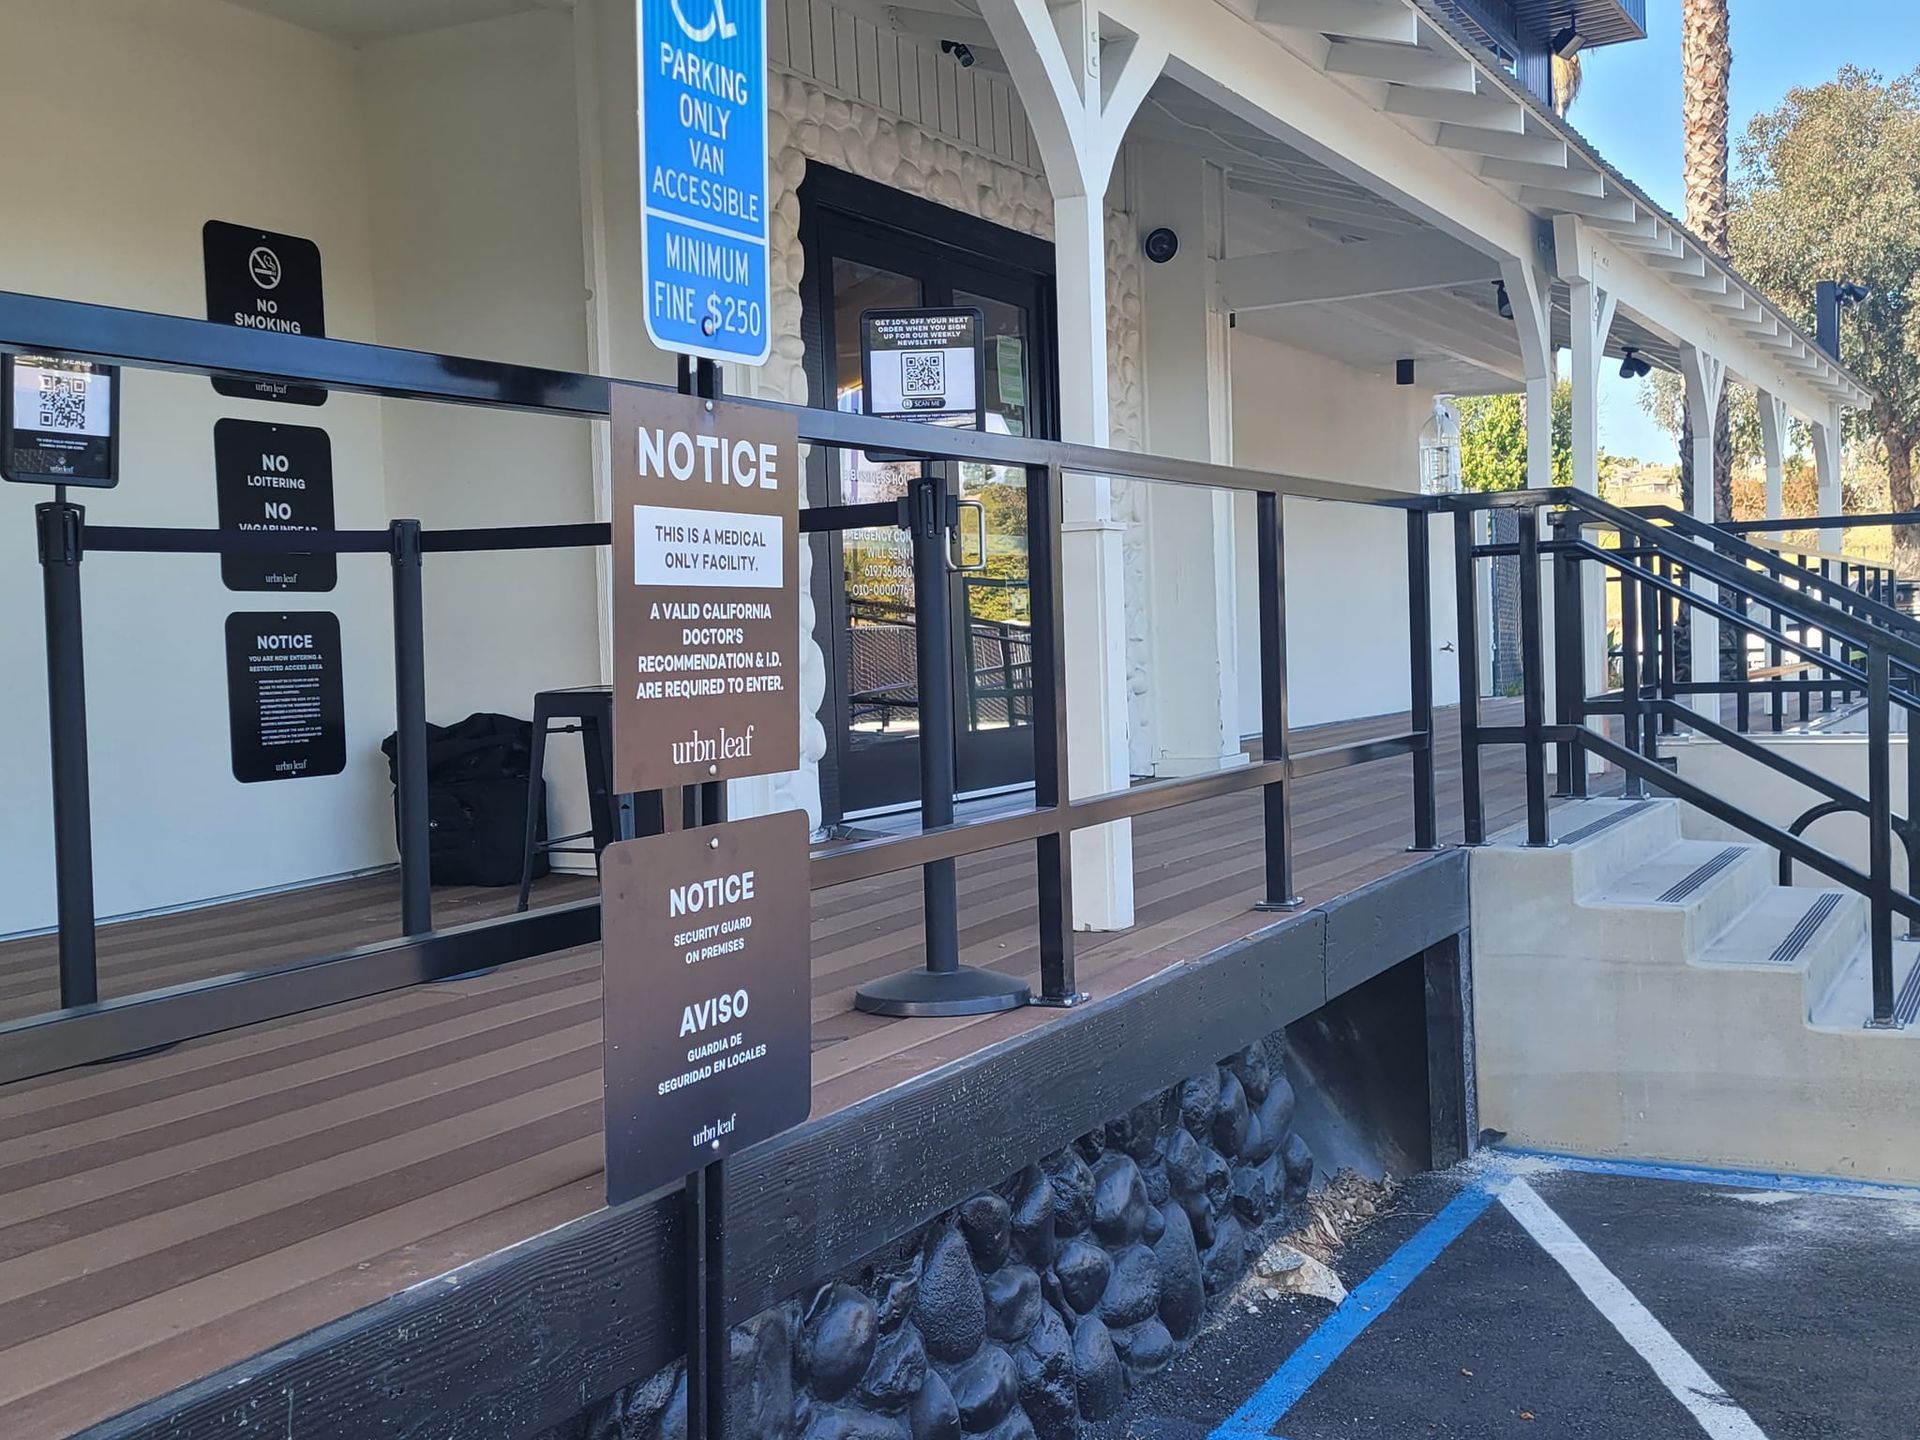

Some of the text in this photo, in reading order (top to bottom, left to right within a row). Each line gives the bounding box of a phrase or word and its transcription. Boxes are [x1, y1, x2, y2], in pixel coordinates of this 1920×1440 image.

[660, 43, 747, 105] PARKING
[679, 93, 731, 140] ONLY
[689, 138, 724, 176] VAN
[652, 166, 759, 222] ACCESSIBLE
[666, 232, 749, 286] MINIMUM
[257, 298, 277, 314] NO
[655, 281, 760, 336] FINE $250
[234, 312, 301, 334] SMOKING
[948, 316, 968, 324] NEXT
[897, 338, 947, 346] NEWSLETTER
[930, 330, 961, 338] WEEKLY
[914, 399, 930, 408] SCAN
[262, 454, 289, 472] NO
[639, 426, 778, 490] NOTICE
[247, 475, 306, 490] LOITERING
[265, 502, 292, 520] NO
[655, 525, 766, 547] THIS IS A MEDICAL
[665, 552, 758, 571] ONLY FACILITY.
[650, 603, 772, 620] A VALID CALIFORNIA
[257, 634, 313, 650] NOTICE
[682, 628, 743, 646] DOCTOR'S
[638, 651, 782, 673] RECOMMENDATION & I.D.
[636, 675, 784, 700] ARE REQUIRED TO ENTER.
[672, 724, 754, 765] urbn leaf
[669, 870, 755, 918] NOTICE
[674, 916, 752, 947] SECURITY GUARD
[685, 938, 745, 965] ON PREMISES
[678, 988, 749, 1038] AVISO
[687, 1032, 743, 1063] GUARDIA DE
[658, 1043, 767, 1096] SEGURIDAD EN LOCALES
[692, 1113, 737, 1148] urbn leaf
